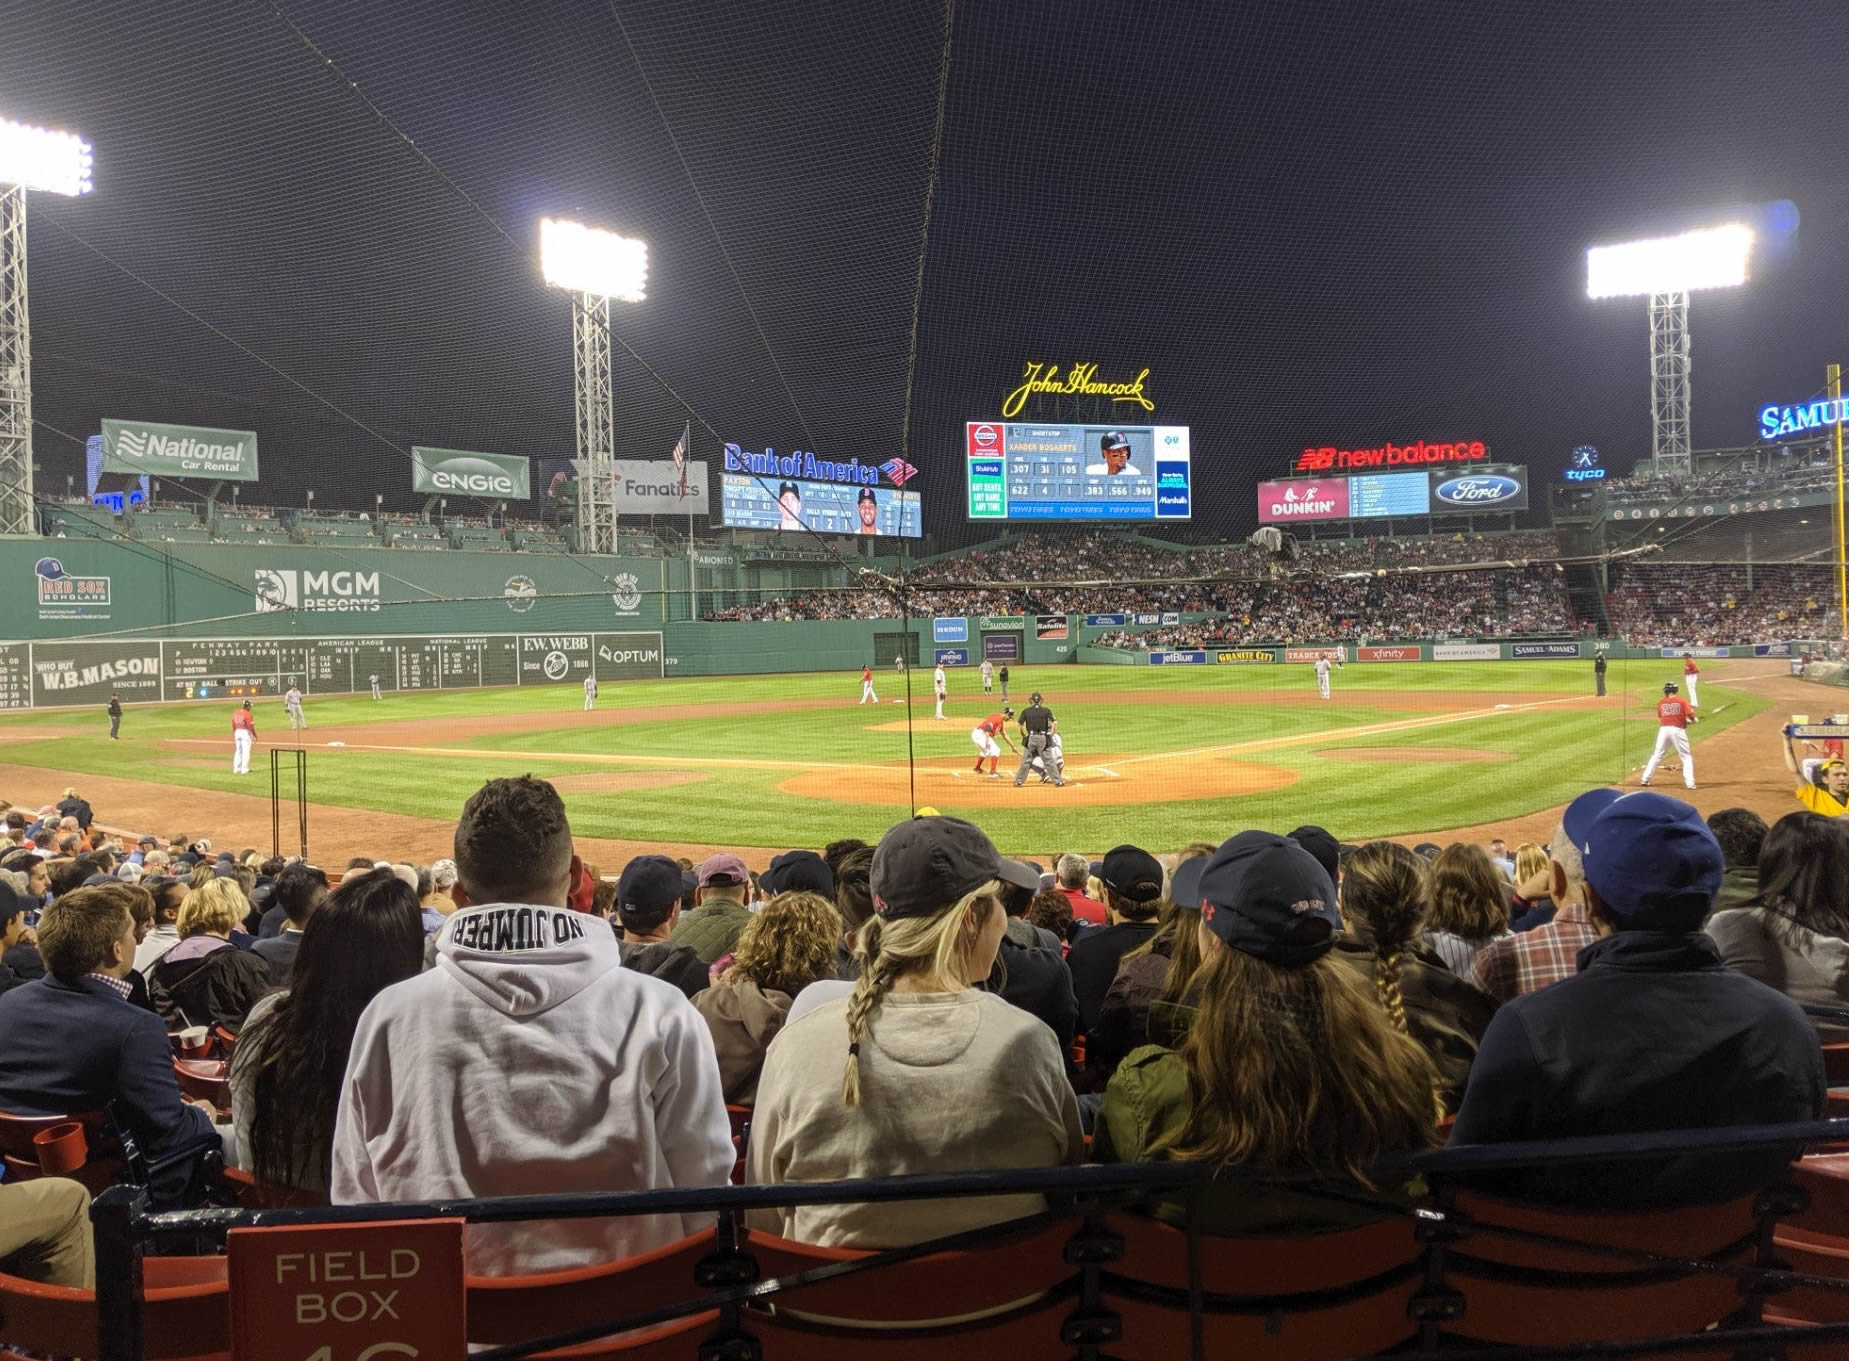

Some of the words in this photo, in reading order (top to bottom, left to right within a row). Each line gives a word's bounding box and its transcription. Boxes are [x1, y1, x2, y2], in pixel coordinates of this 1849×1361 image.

[1002, 360, 1063, 418] John
[1063, 362, 1155, 411] Hancock
[147, 434, 243, 462] National
[181, 459, 200, 470] Car
[204, 461, 240, 473] Rental
[724, 443, 780, 474] Bank
[781, 451, 801, 477] of
[803, 452, 879, 485] America
[1010, 465, 1029, 474] .307
[1041, 465, 1050, 474] 31
[1062, 465, 1077, 474] 105
[1567, 469, 1606, 481] tyco
[1012, 486, 1028, 495] 622
[1042, 486, 1048, 495] 4
[1084, 486, 1103, 496] .383
[1109, 486, 1128, 496] .566
[1133, 486, 1152, 496] .949
[1451, 480, 1502, 501] Ford
[1159, 496, 1188, 504] Marshalls
[1271, 501, 1335, 516] DUNKIN'
[827, 519, 833, 530] 2
[699, 556, 734, 566] ABIOMED
[43, 581, 73, 594] RED
[77, 581, 105, 594] SOX
[303, 570, 380, 595] MGM
[303, 598, 380, 612] RESORTS
[1138, 614, 1160, 624] NESN
[1037, 622, 1068, 630] Safelite
[549, 637, 588, 650] WEBB
[1056, 645, 1068, 653] 420
[1593, 642, 1610, 650] 380
[1372, 648, 1405, 660] xfinity
[1515, 645, 1545, 655] SAMUEL
[1548, 645, 1576, 654] ADAMS
[613, 649, 659, 664] OPTUM
[1162, 651, 1194, 664] jetBlue
[1218, 652, 1254, 663] GRANITE
[1255, 651, 1275, 663] CITY
[34, 662, 57, 671] WHO
[58, 661, 74, 671] BUT
[523, 662, 541, 670] Since
[112, 681, 137, 689] SINCE
[453, 907, 548, 951] JUMPER
[553, 912, 585, 944] NO
[276, 1249, 421, 1284] FIELD
[296, 1289, 400, 1324] BOX
